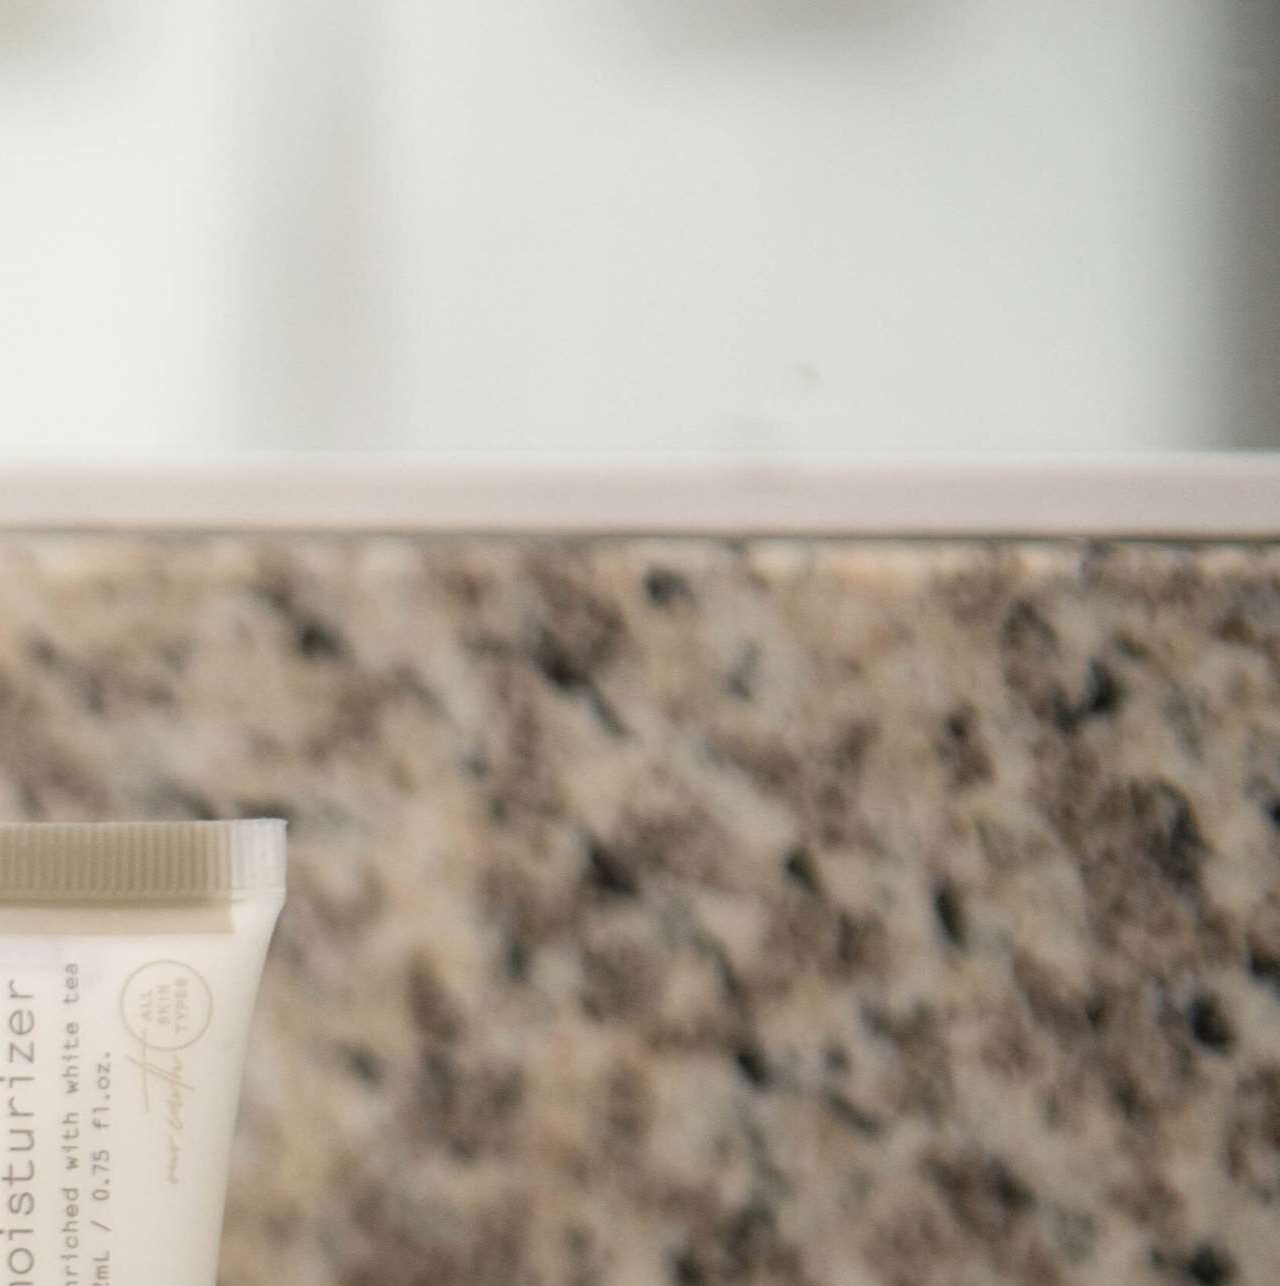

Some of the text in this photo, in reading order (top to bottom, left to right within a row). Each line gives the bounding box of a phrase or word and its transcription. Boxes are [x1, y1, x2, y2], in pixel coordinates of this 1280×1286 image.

[63, 963, 79, 1004] tea
[141, 989, 153, 1022] ALL
[157, 984, 171, 1026] SKIN
[174, 977, 189, 1034] TYPES
[61, 1021, 79, 1094] white
[92, 1050, 110, 1130] fl.oz.
[62, 1112, 79, 1170] with
[93, 1149, 110, 1201] 0.75
[92, 1221, 110, 1232] /
